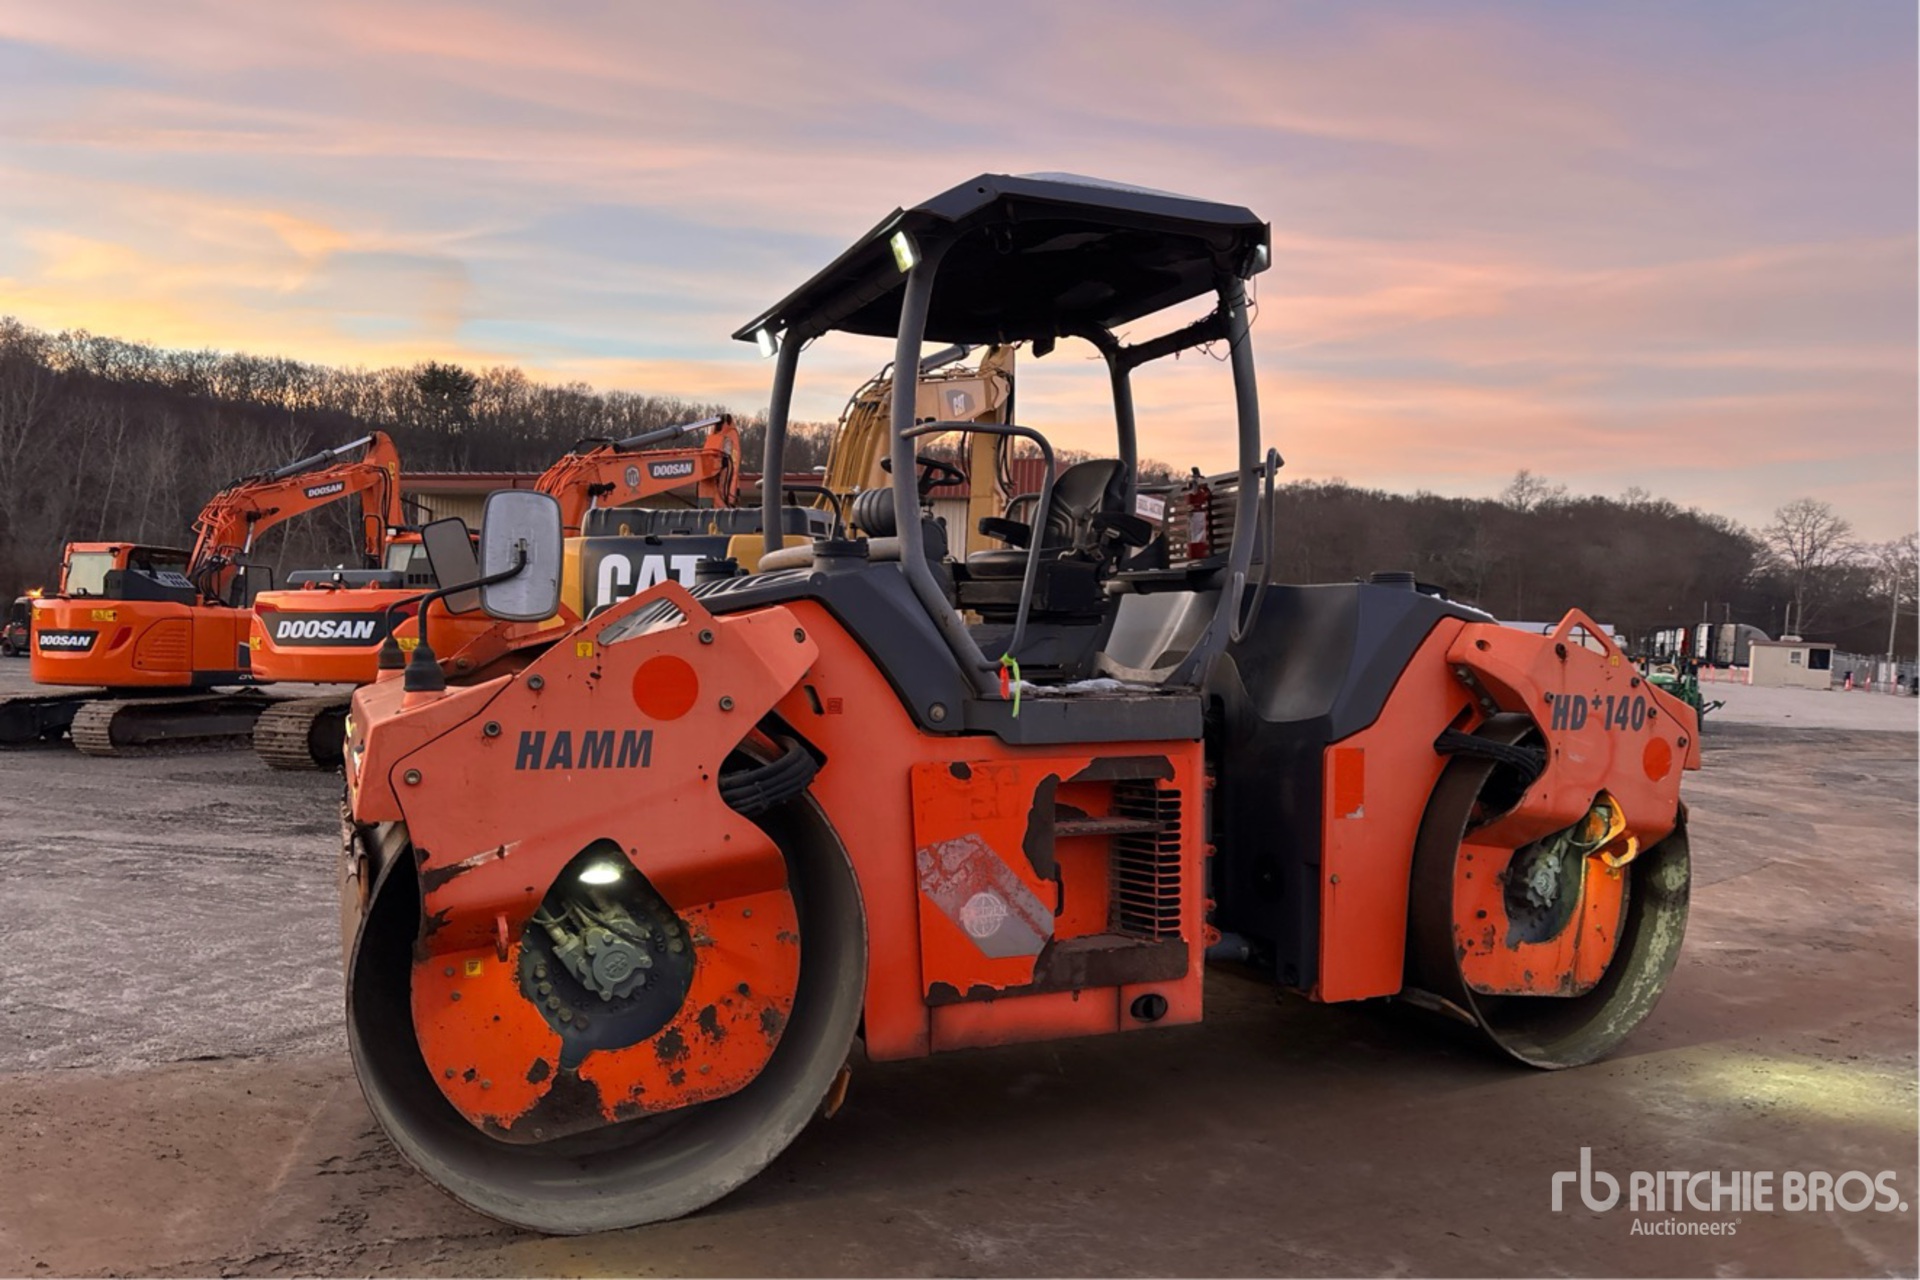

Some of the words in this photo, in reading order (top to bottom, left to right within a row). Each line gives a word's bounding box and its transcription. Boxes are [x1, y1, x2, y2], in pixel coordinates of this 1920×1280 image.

[653, 463, 693, 477] DOOSAN
[308, 483, 343, 497] DOOSAN
[276, 620, 376, 639] DOOSAN
[40, 635, 91, 647] DOOSAN
[515, 730, 654, 770] HAMM
